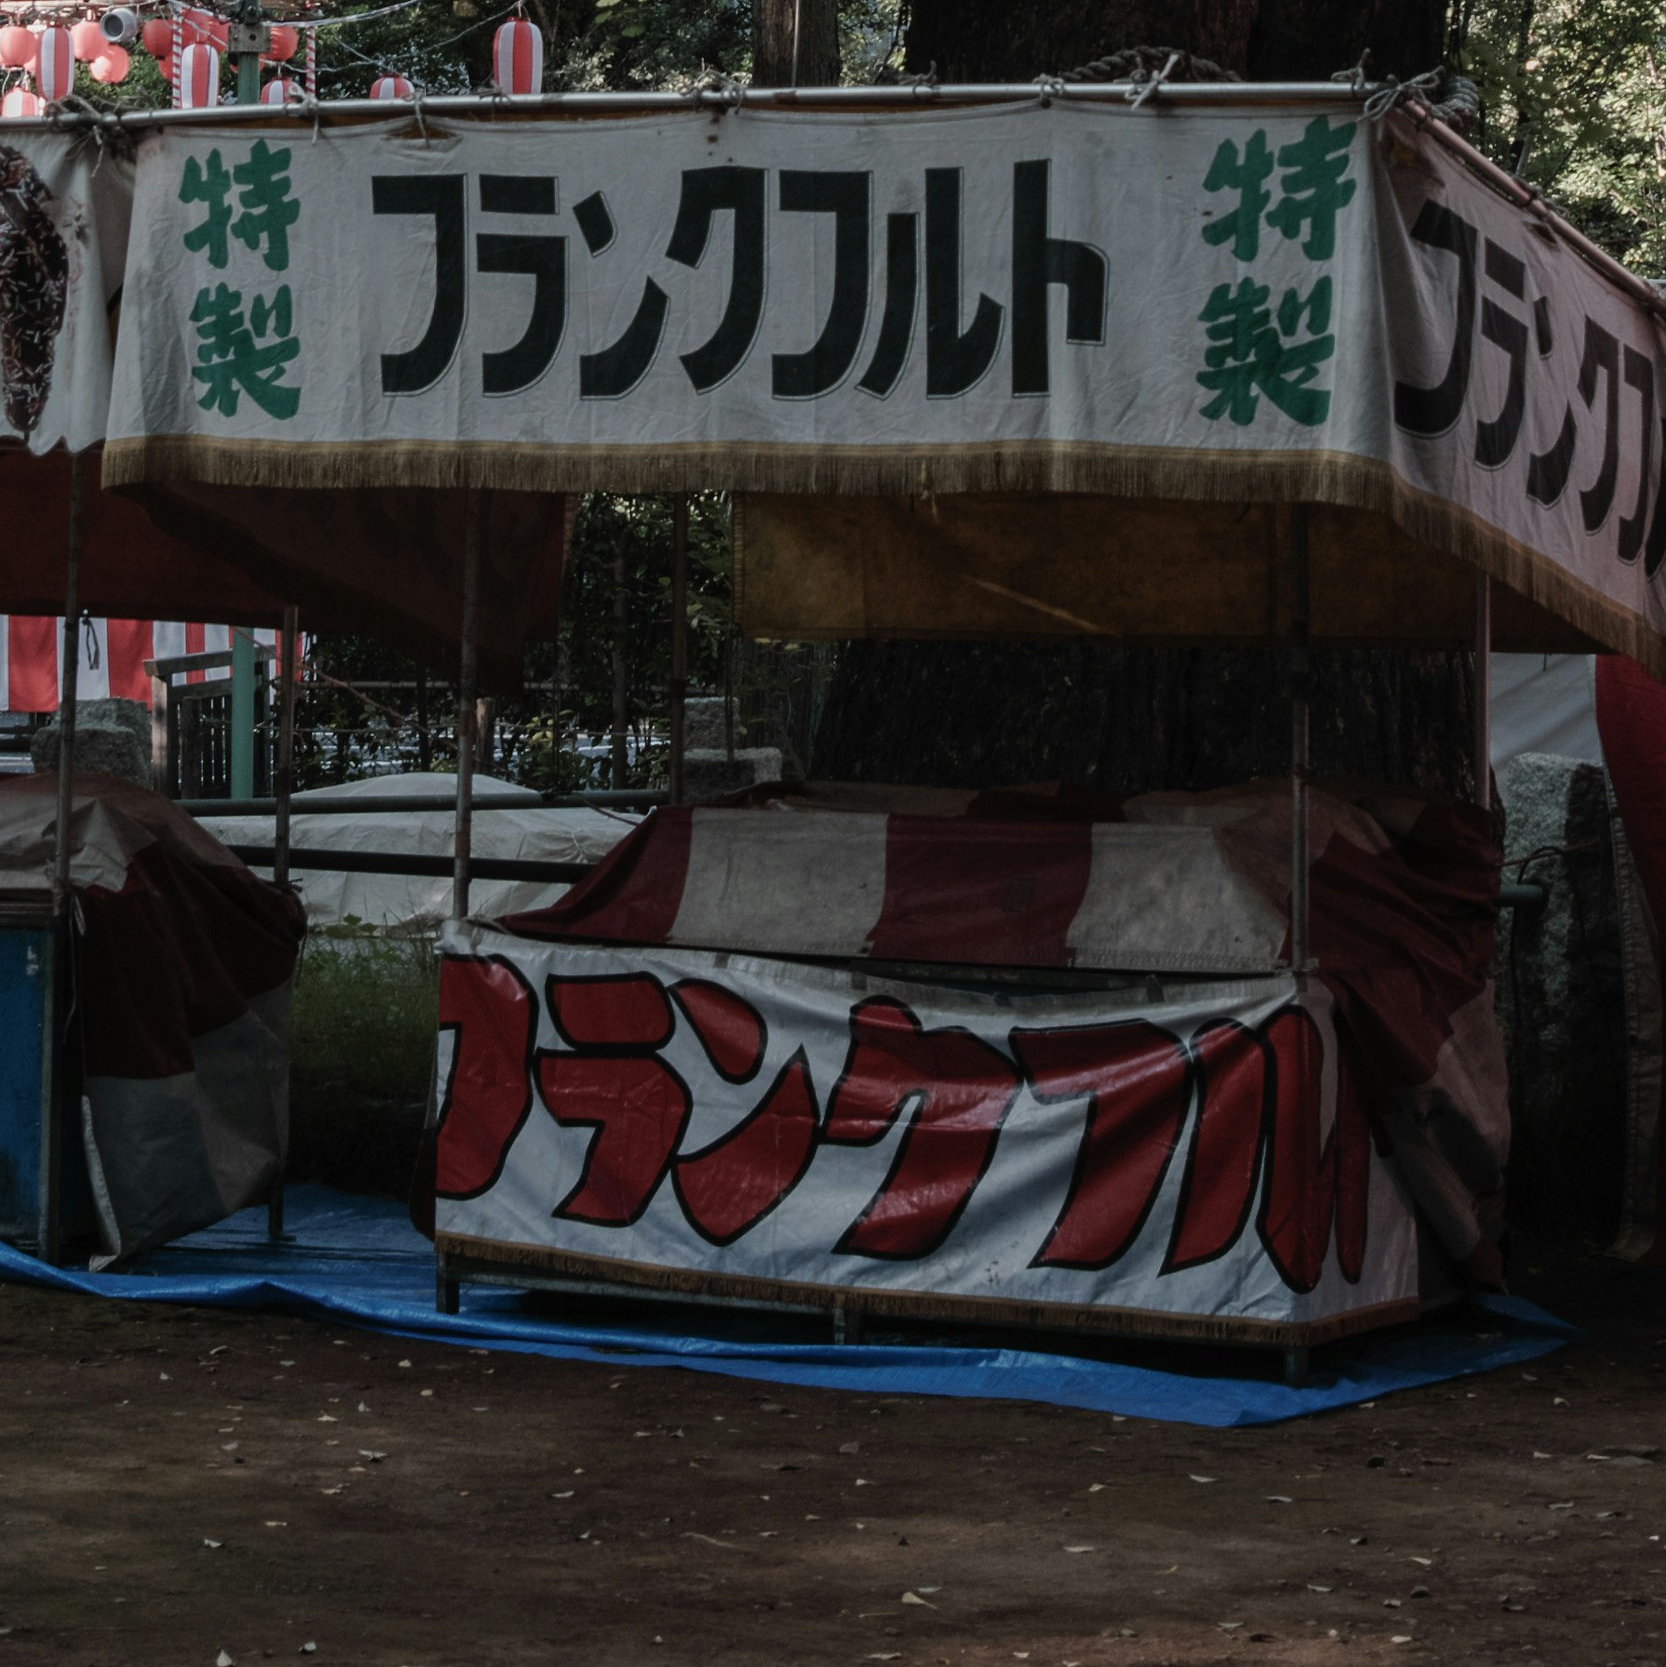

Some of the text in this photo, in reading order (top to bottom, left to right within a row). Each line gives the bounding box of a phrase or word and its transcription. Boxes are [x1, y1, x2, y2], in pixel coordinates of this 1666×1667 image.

[178, 137, 303, 423] 特製
[370, 159, 1109, 401] フランクフルト
[1195, 114, 1359, 427] 特製
